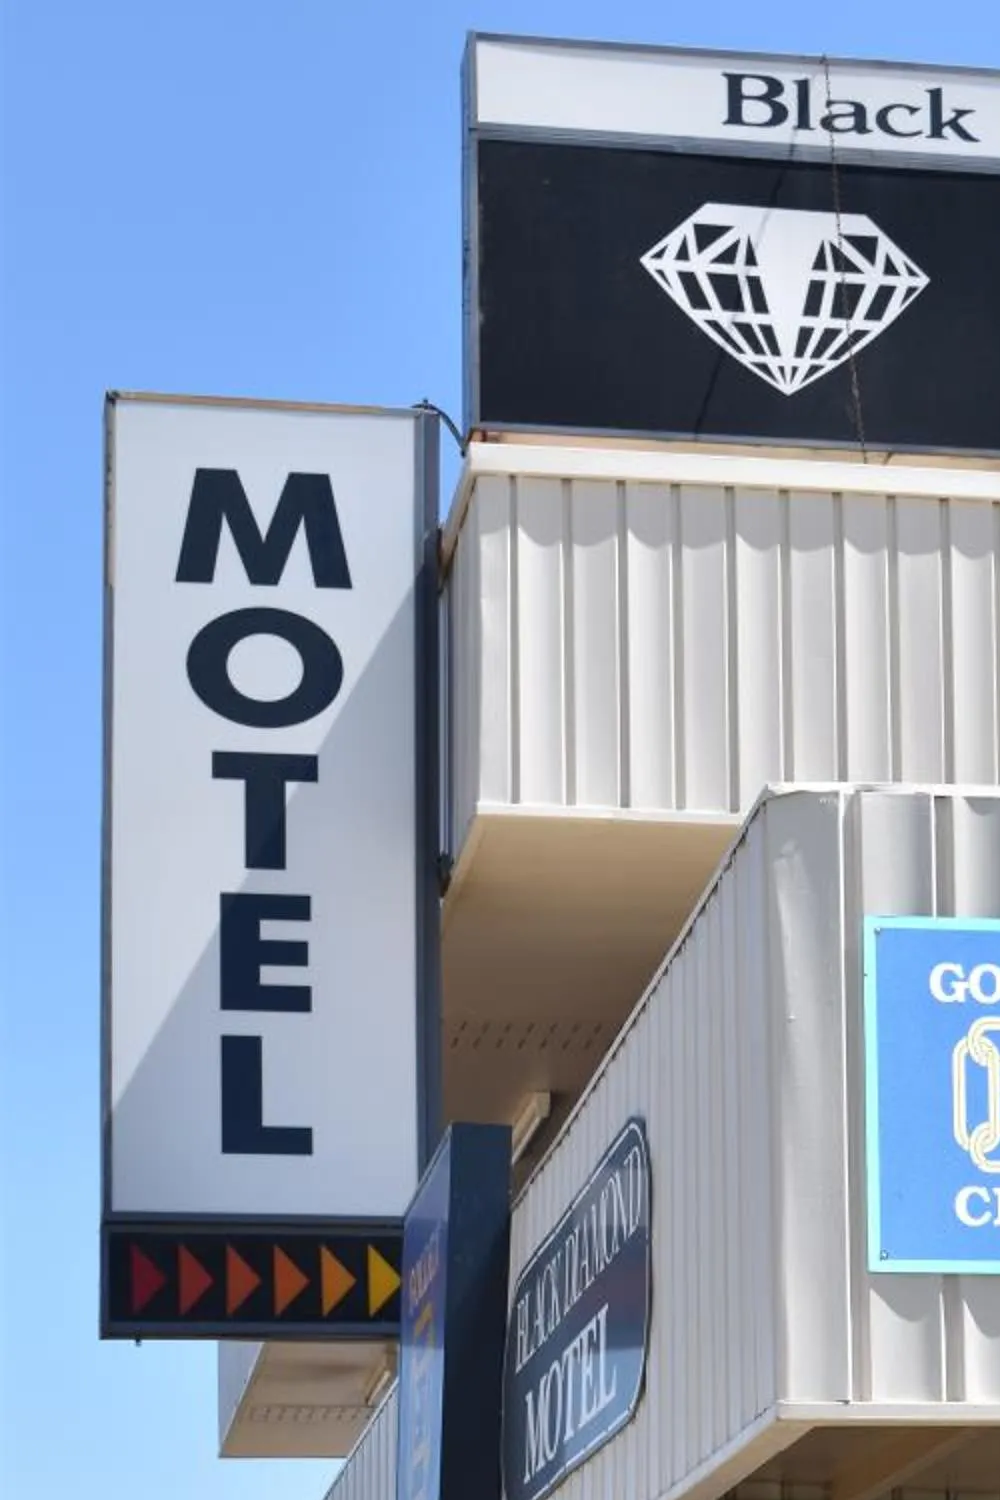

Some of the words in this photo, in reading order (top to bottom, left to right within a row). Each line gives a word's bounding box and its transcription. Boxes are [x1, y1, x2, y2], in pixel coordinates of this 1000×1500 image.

[721, 71, 979, 146] Black
[175, 467, 353, 1156] MOTEL
[514, 1250, 562, 1374] BLACK
[563, 1145, 643, 1317] DIAMOND
[523, 1303, 617, 1485] MOTEL
